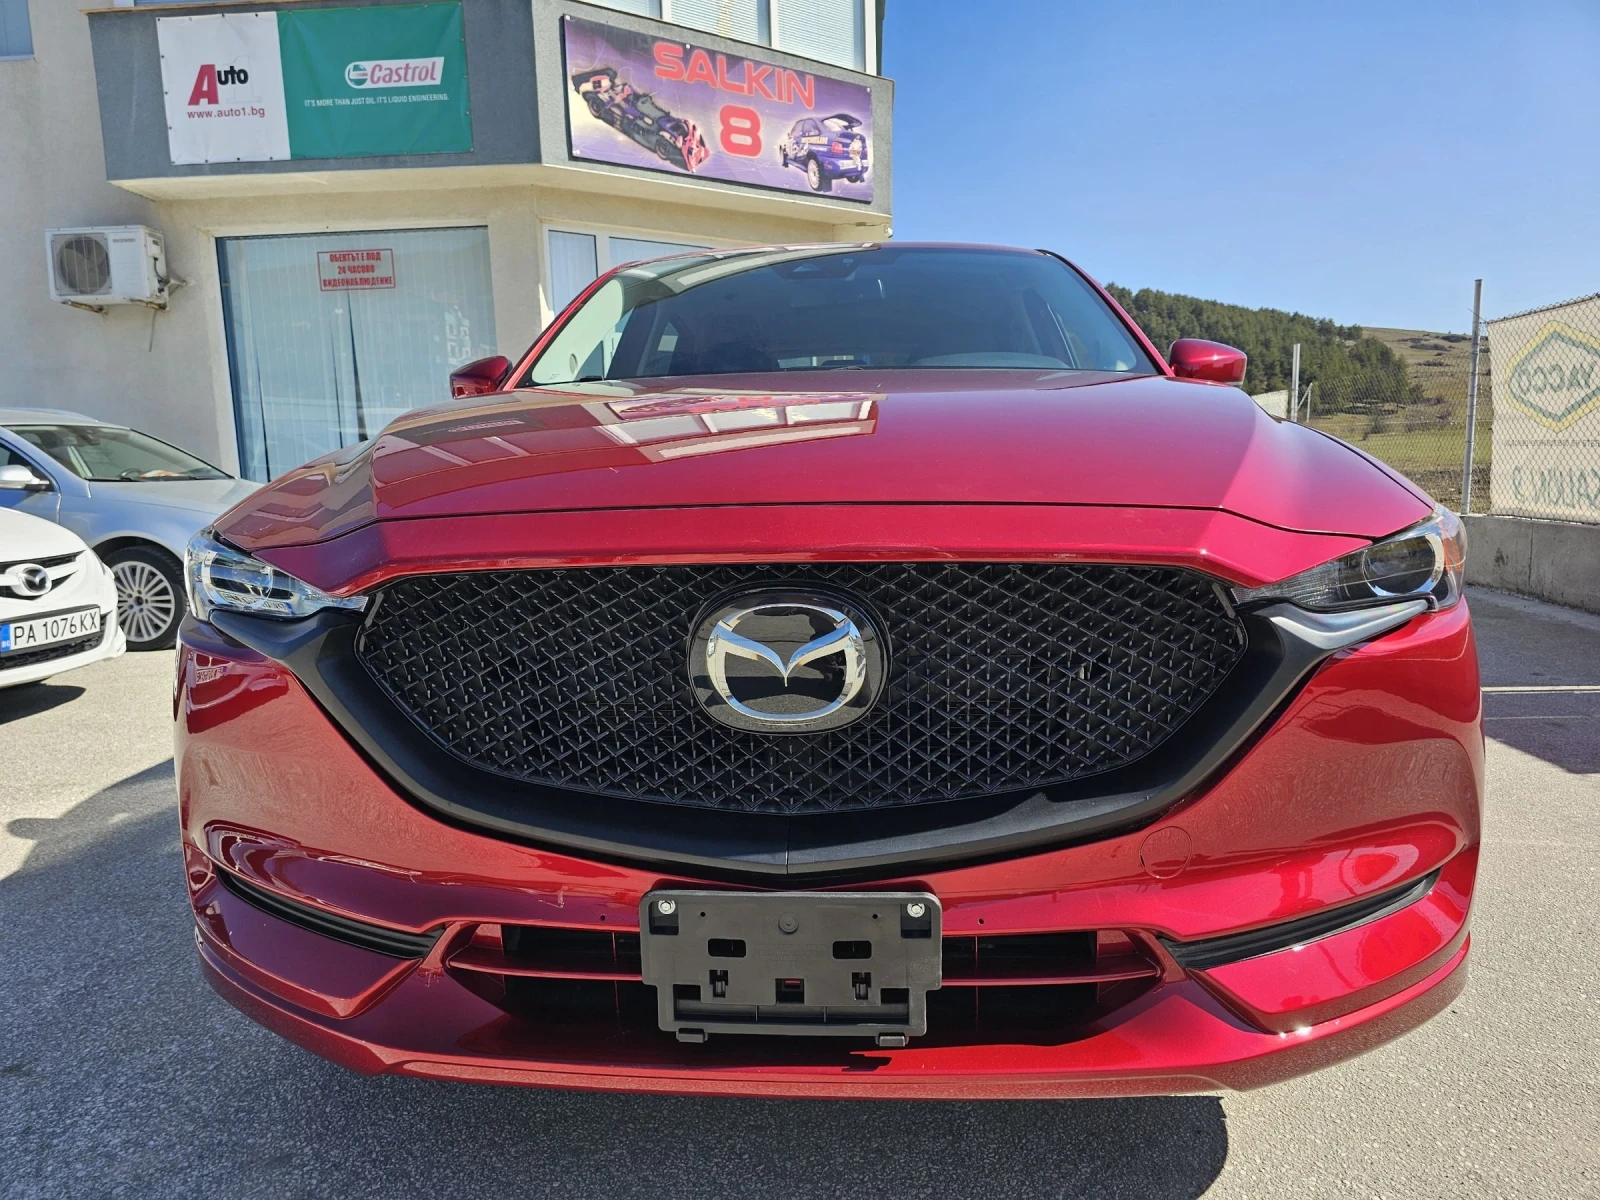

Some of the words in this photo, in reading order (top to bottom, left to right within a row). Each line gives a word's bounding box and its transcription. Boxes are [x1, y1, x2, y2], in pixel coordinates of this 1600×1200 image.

[369, 60, 437, 86] Castrol
[653, 42, 815, 109] SALKIN
[187, 63, 249, 106] Auto
[316, 98, 333, 107] MORE
[334, 98, 351, 106] THAN
[388, 95, 408, 103] LIQUID
[187, 106, 266, 118] www.auto1.bg
[719, 104, 763, 158] 8
[330, 252, 360, 262] ОБЕКТЪТ
[366, 252, 381, 262] ПОД
[337, 265, 347, 275] 24
[347, 264, 375, 273] ЧАСОВО
